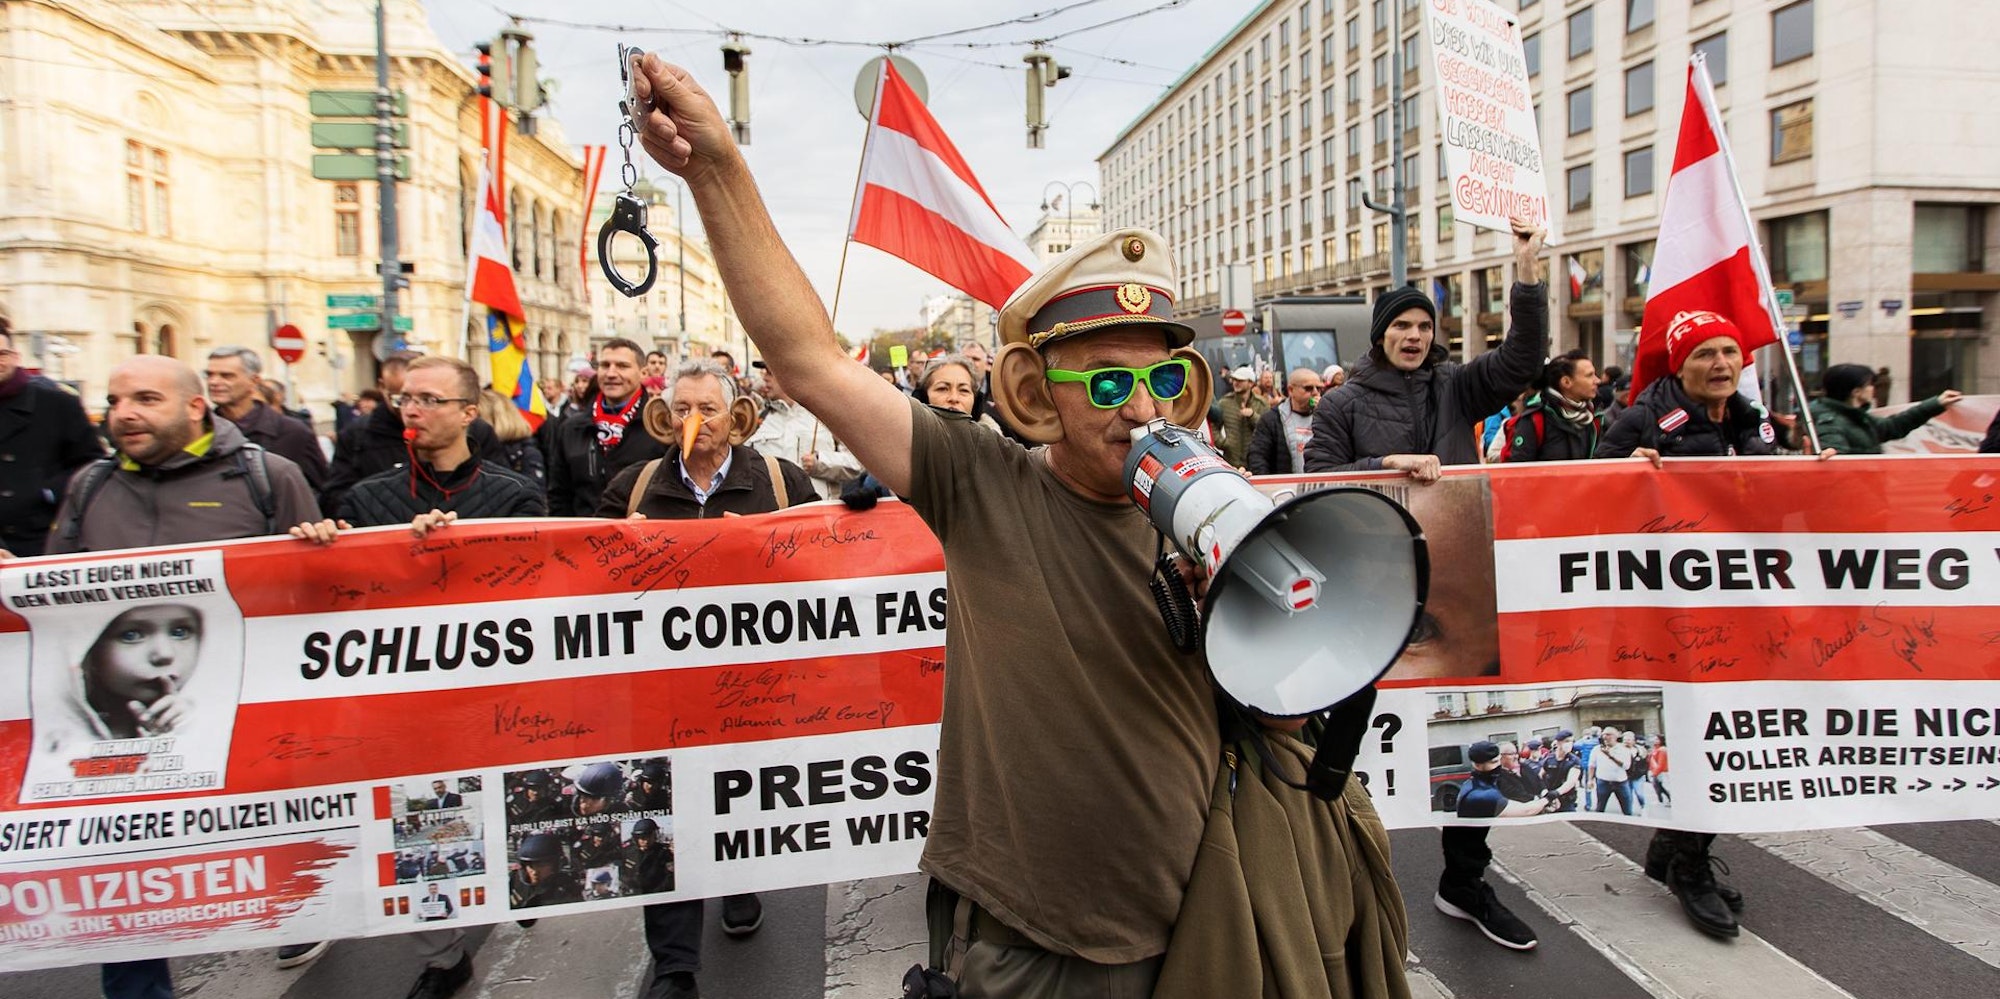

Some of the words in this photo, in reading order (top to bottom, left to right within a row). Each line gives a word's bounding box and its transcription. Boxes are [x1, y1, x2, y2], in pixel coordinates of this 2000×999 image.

[1433, 17, 1469, 57] DASS
[1471, 35, 1496, 69] WIR
[1498, 50, 1525, 82] UNS
[1470, 150, 1516, 185] NICHT
[25, 568, 82, 588] LASST
[88, 564, 134, 583] EUCH
[141, 559, 194, 578] NICHT
[1560, 549, 1796, 593] FINGER
[1817, 547, 1970, 591] WEG
[11, 594, 50, 608] DEN
[52, 587, 109, 604] MUND
[111, 578, 215, 600] VERBIETEN!
[300, 618, 534, 680] SCHLUSS
[553, 610, 643, 661] MIT
[662, 596, 860, 651] CORONA
[1703, 708, 1810, 740] ABER
[1825, 708, 1899, 736] DIE
[1914, 707, 2000, 737] NIC
[1705, 747, 1811, 772] VOLLER
[1818, 745, 2000, 766] ARBEITSEIN
[713, 750, 939, 816] PRESS
[1709, 779, 1794, 803] SIEHE
[1801, 775, 1898, 799] BILDER
[0, 819, 72, 851] SIERT
[79, 811, 174, 845] UNSERE
[184, 801, 277, 836] POLIZEI
[285, 792, 357, 821] NICHT
[611, 810, 642, 822] SCHÄM
[643, 809, 665, 820] DICH
[714, 820, 831, 862] MIKE
[115, 898, 268, 931] VERBRECHER!
